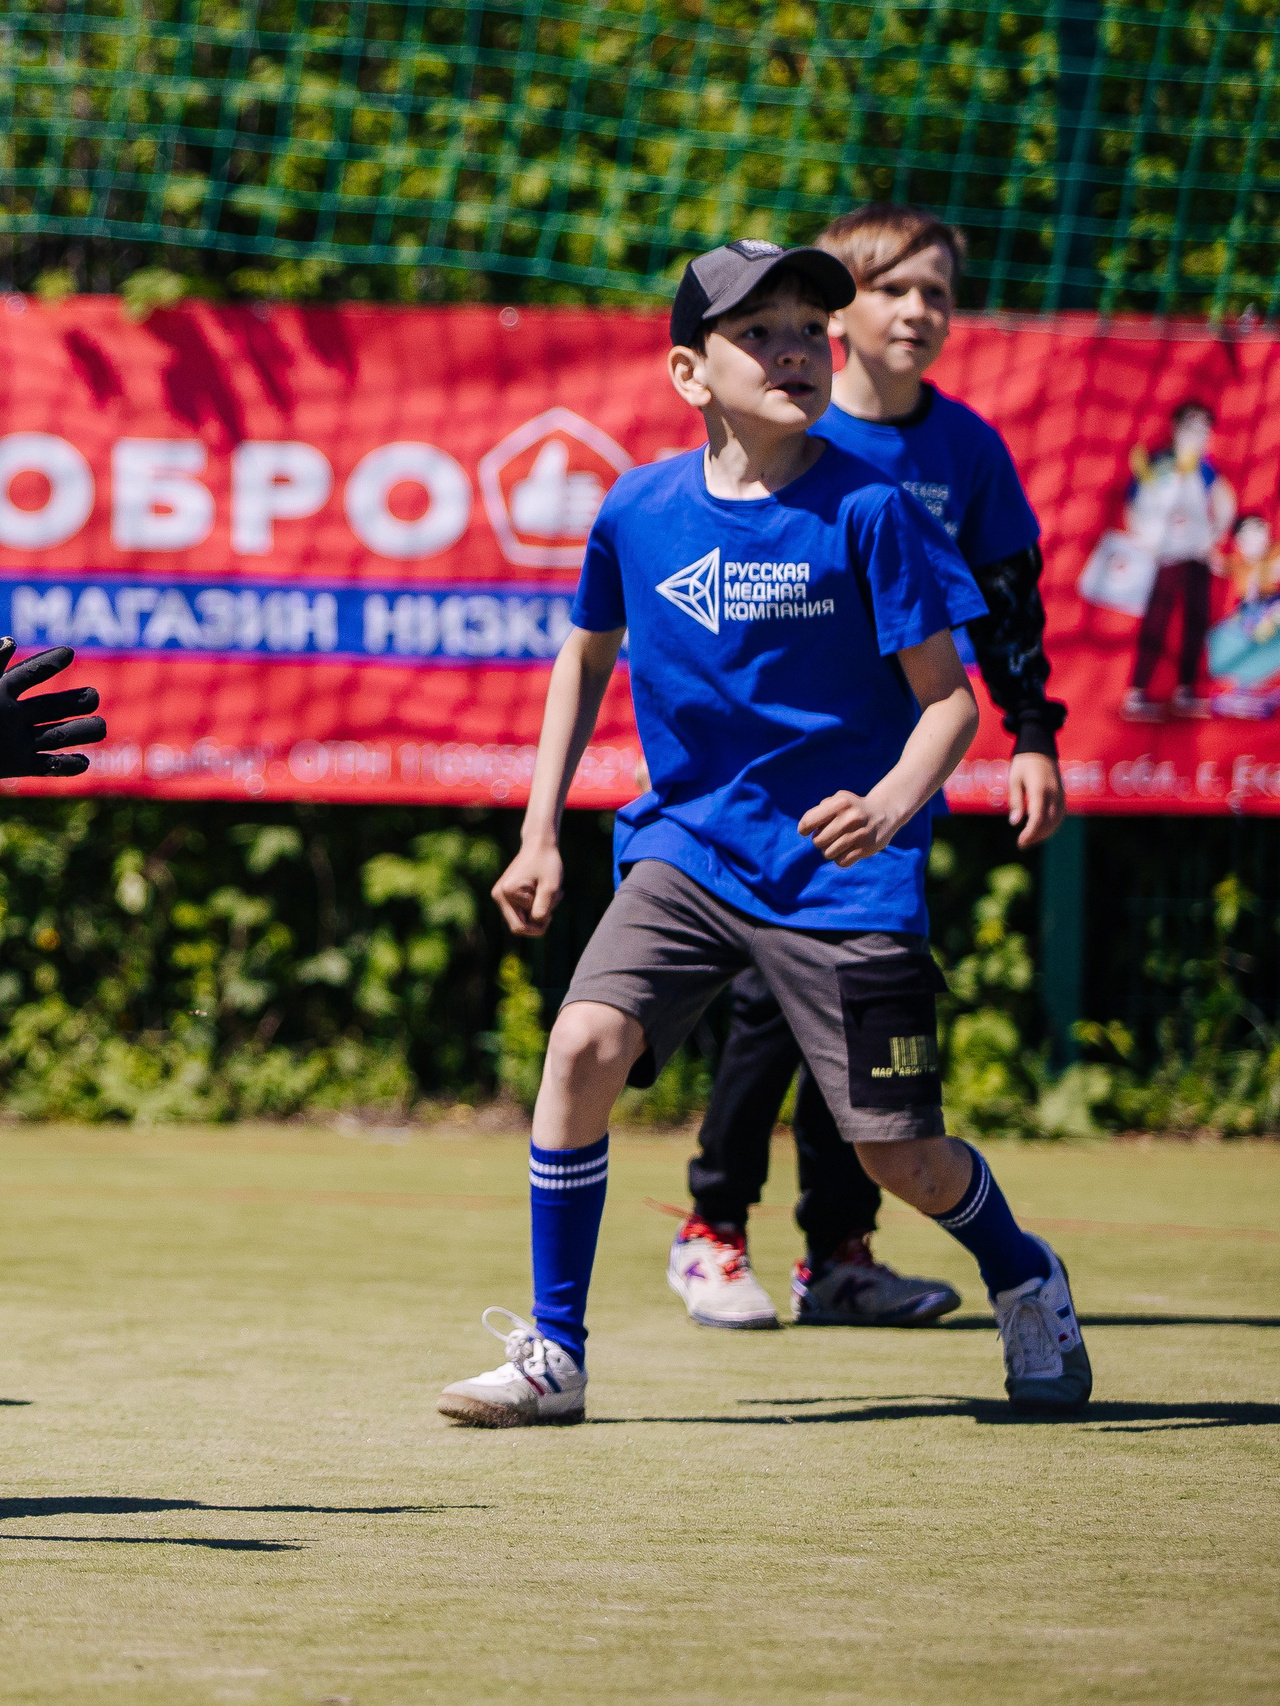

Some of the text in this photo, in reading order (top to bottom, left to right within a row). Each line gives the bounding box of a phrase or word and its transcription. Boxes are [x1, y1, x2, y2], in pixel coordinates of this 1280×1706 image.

[723, 562, 810, 582] РУССКАЯ
[723, 583, 807, 602] МЕДНАЯ
[11, 585, 338, 653] МАГАЗИН
[723, 599, 835, 621] КОМПАНИЯ
